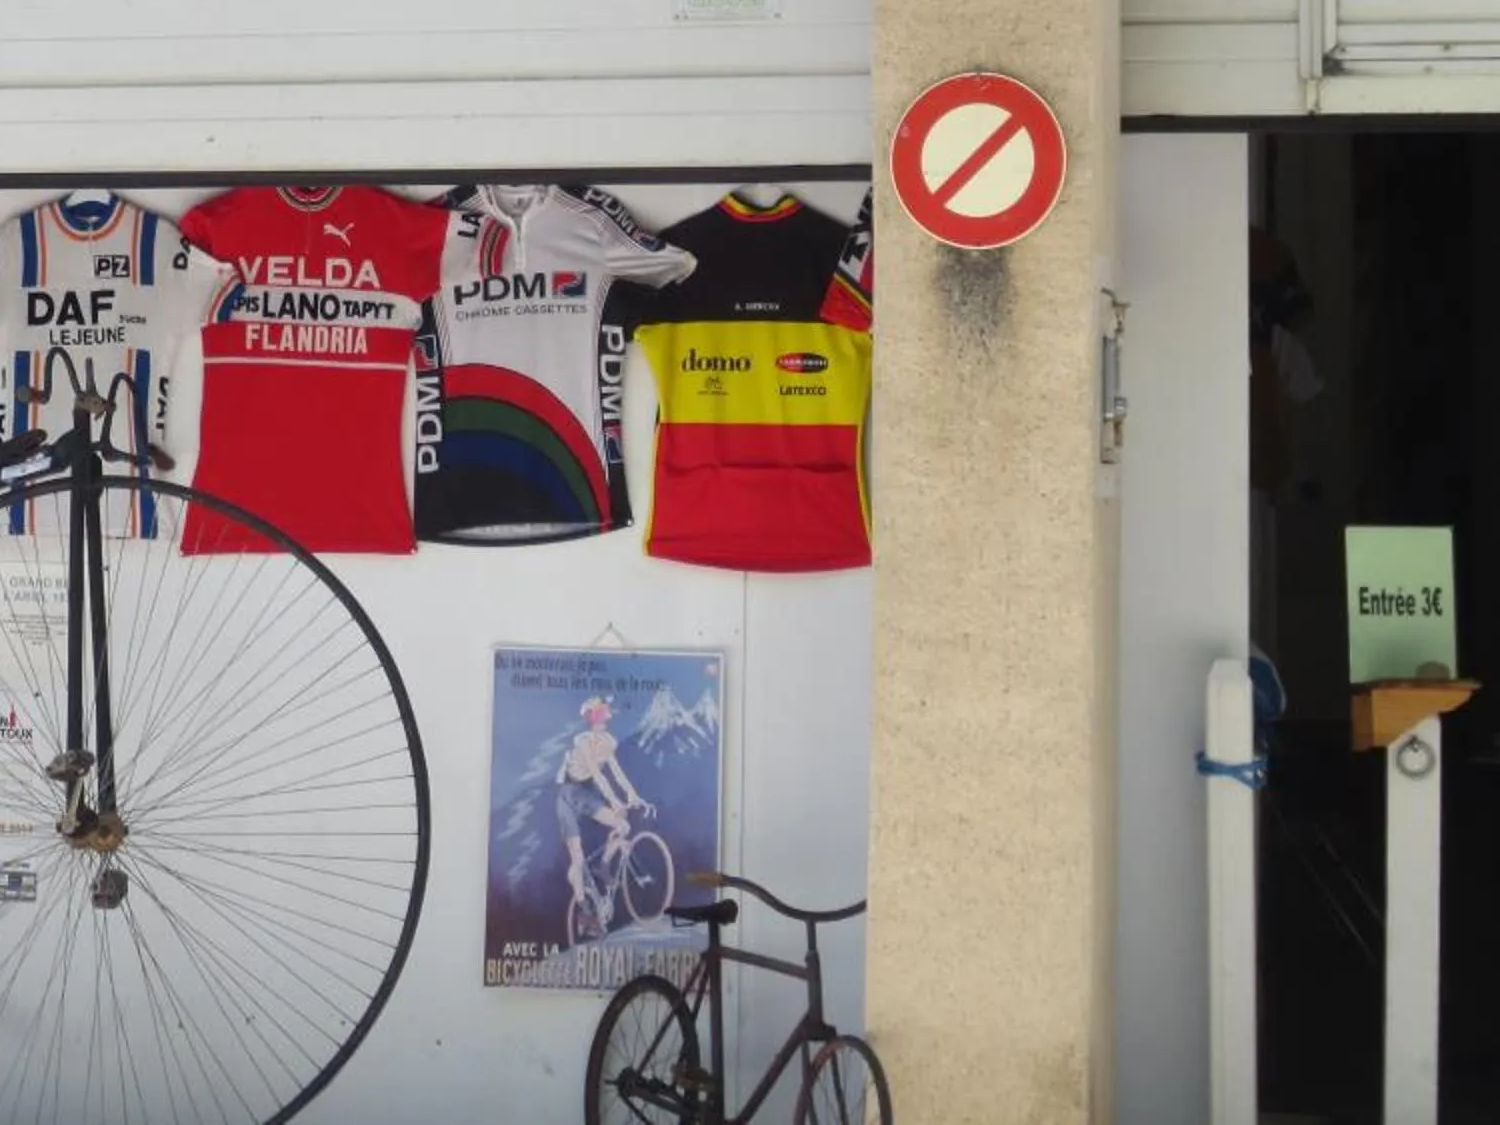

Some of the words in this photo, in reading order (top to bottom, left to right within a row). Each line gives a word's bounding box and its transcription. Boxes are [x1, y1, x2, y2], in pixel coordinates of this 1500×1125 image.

[238, 256, 381, 289] VELDA
[453, 272, 547, 306] PDM
[27, 289, 116, 326] DAF
[262, 291, 341, 321] LANO
[342, 301, 395, 320] TAPYT
[50, 327, 125, 347] LEJEUNE
[245, 325, 369, 355] FLANDRIA
[601, 325, 626, 421] PDM
[681, 348, 751, 373] domo
[417, 375, 443, 474] PDM
[1359, 586, 1415, 616] Entrée
[1421, 586, 1443, 616] 3€
[503, 942, 536, 957] AVEC
[543, 942, 560, 955] LA
